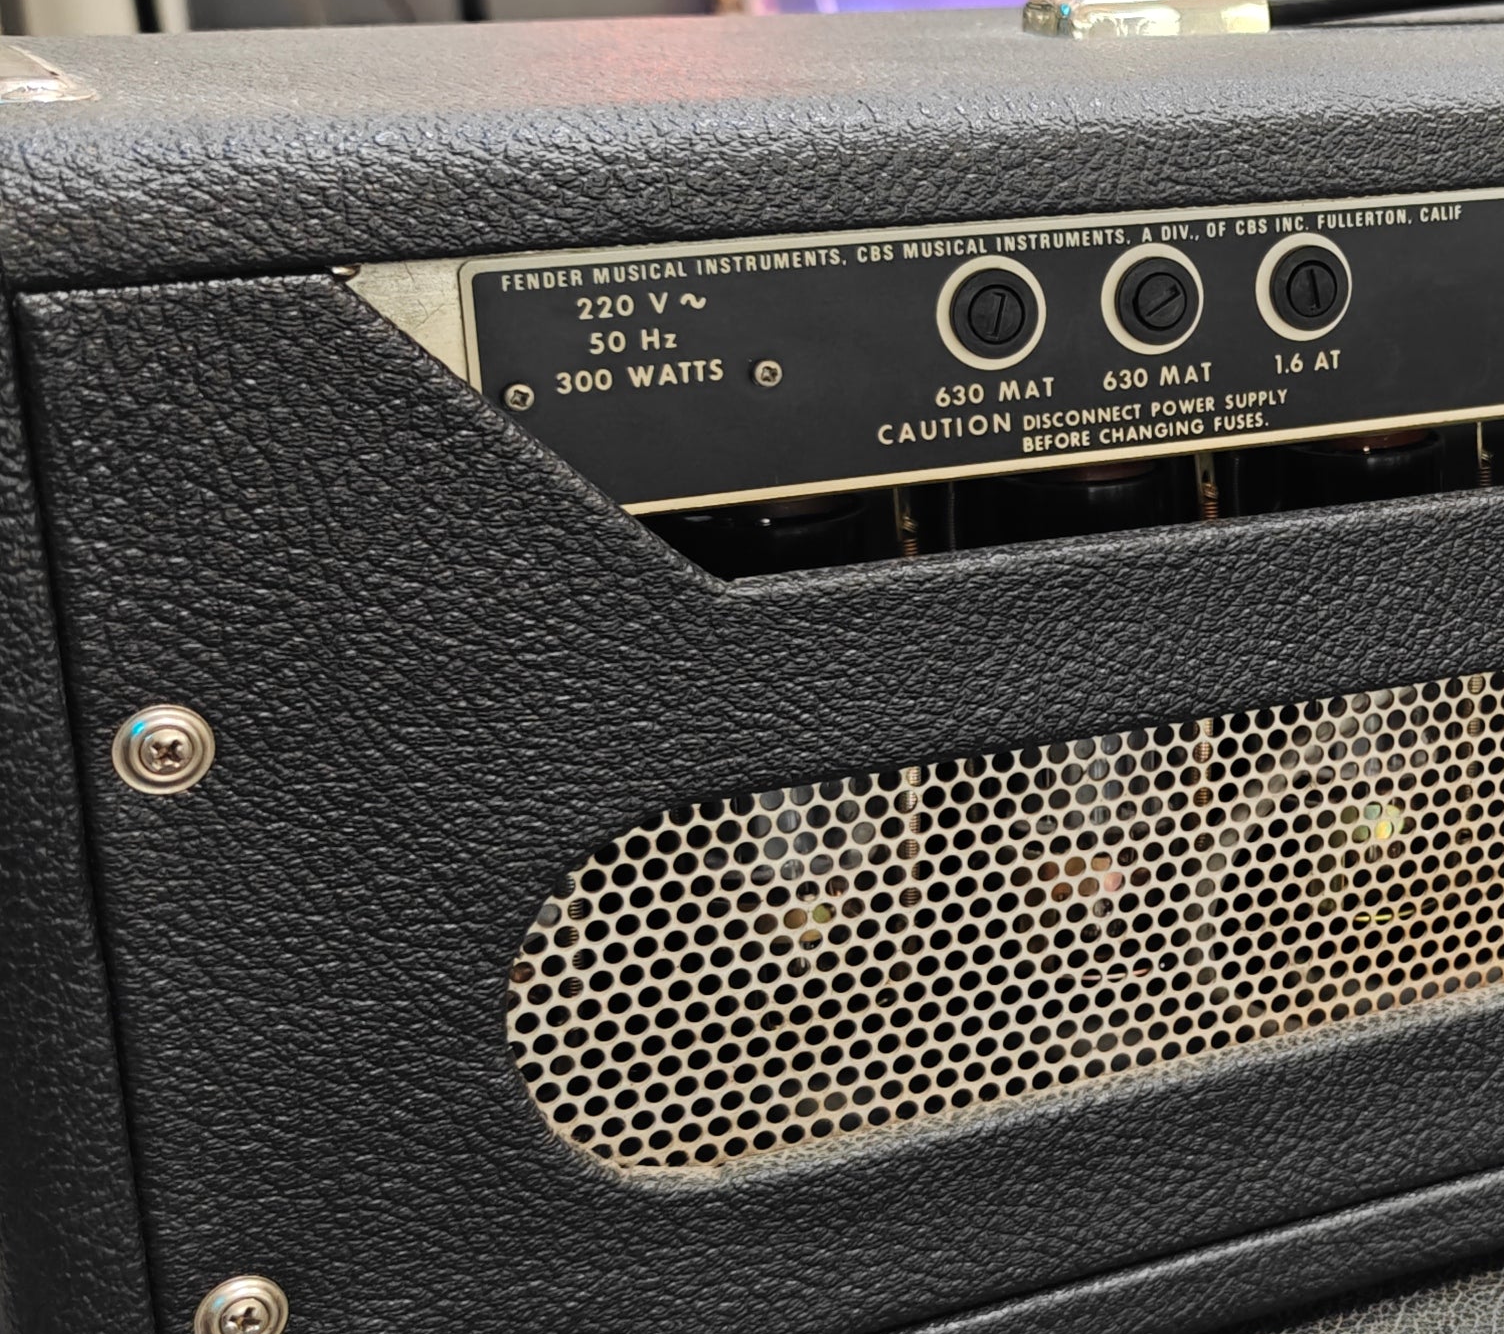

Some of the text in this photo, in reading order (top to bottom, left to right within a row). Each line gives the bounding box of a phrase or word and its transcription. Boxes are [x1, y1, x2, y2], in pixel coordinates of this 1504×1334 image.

[501, 269, 583, 292] FENDER
[594, 262, 687, 285] MUSICAL
[857, 243, 894, 263] CBS
[903, 237, 987, 259] MUSICAL
[1142, 227, 1152, 243] A
[1206, 221, 1226, 238] OF
[1235, 218, 1267, 235] CBS
[1275, 216, 1309, 233] INC.
[1419, 205, 1462, 222] CALIF
[576, 294, 635, 320] 220
[649, 293, 669, 315] V
[589, 328, 677, 355] 50 Hz
[555, 358, 724, 394] 300 WATTS
[1102, 363, 1212, 392] 630 MAT
[1274, 350, 1341, 375] 1.6 AT
[934, 377, 1055, 407] 630 MAT
[1022, 389, 1288, 432] DISCONNECT POWER SUPPLY
[877, 412, 1012, 446] CAUTION
[1022, 412, 1269, 453] BEFORE CHANGING FUSES.
